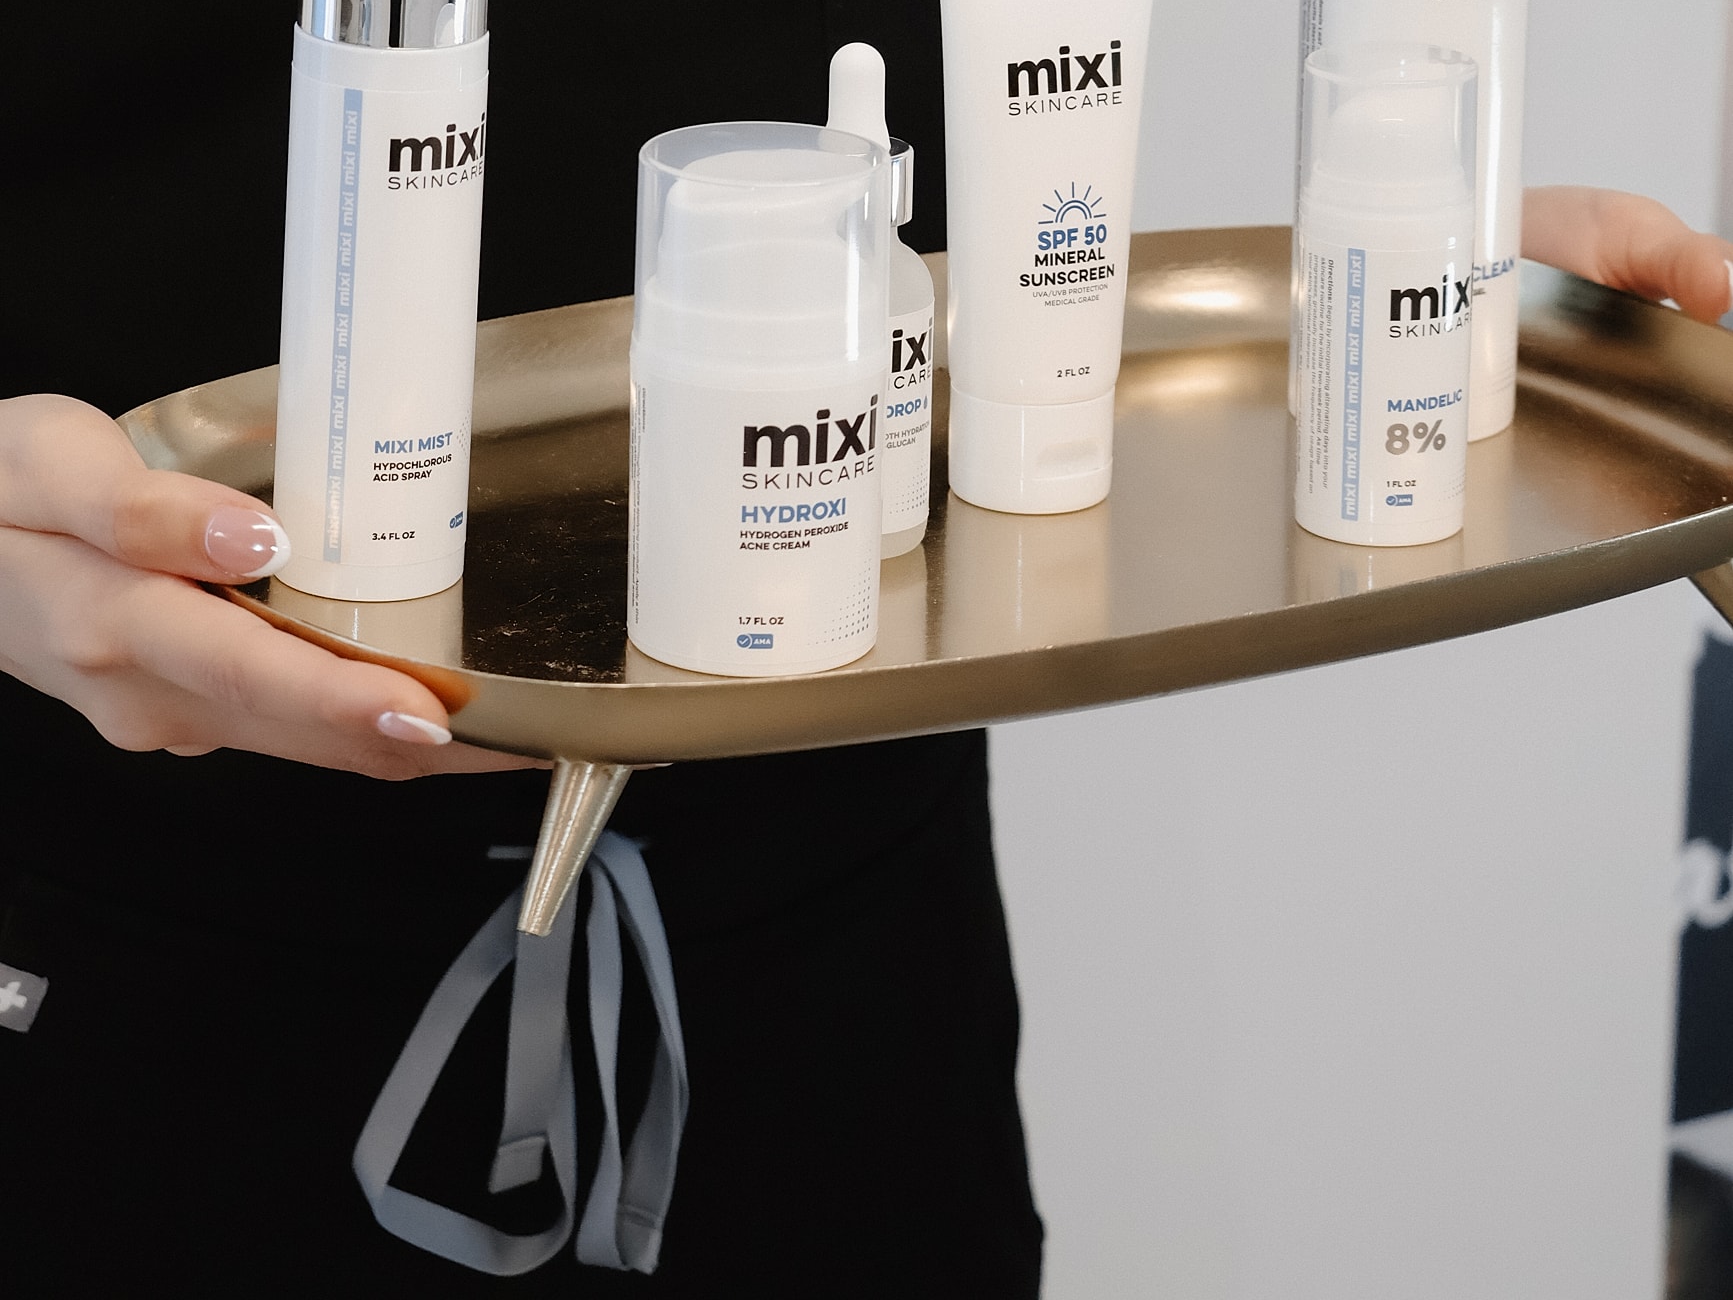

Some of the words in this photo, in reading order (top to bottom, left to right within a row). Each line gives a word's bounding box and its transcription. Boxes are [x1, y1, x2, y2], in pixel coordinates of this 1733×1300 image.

[1007, 40, 1121, 98] mixi
[1008, 91, 1122, 116] SKINCARE
[346, 110, 357, 145] mixi
[388, 111, 485, 172] mixi
[343, 151, 355, 186] mixi
[388, 160, 483, 190] SKINCARE
[342, 192, 354, 227] mixi
[340, 232, 352, 267] mixi
[1038, 228, 1078, 251] SPF
[1084, 224, 1107, 246] 50
[1034, 247, 1105, 267] MINERAL
[1350, 255, 1361, 288] mixi
[338, 272, 350, 307] mixi
[1019, 264, 1115, 288] SUNSCREEN
[1032, 289, 1067, 298] UVA/UVB
[1068, 283, 1108, 295] PROTECTION
[1044, 297, 1076, 307] MEDICAL
[1078, 294, 1099, 304] GRADE
[1349, 295, 1360, 328] mixi
[1390, 272, 1472, 321] mix
[336, 312, 349, 348] mixi
[1389, 312, 1471, 339] SKINCAR
[891, 317, 932, 373] ixi
[1348, 333, 1359, 365] mixi
[334, 354, 347, 390] mixi
[887, 364, 931, 391] CARE
[1057, 370, 1062, 378] 2
[1065, 368, 1076, 377] FL
[1078, 366, 1091, 376] OZ
[1347, 371, 1359, 404] mixi
[332, 395, 345, 429] mixi
[1387, 389, 1462, 412] MANDELIC
[743, 394, 878, 467] mixi
[1346, 409, 1357, 442] mixi
[1385, 419, 1446, 455] 8%
[331, 435, 344, 470] mixi
[374, 440, 413, 454] MIXI
[418, 432, 453, 452] MIST
[373, 454, 452, 470] HYPOCHLOROUS
[373, 473, 399, 482] ACID
[401, 469, 432, 481] SPRAY
[742, 454, 875, 490] SKINCARE
[1345, 446, 1357, 479] mixi
[741, 497, 847, 524] HYDROXI
[1344, 483, 1356, 516] mixi
[372, 533, 387, 541] 3.4
[388, 532, 400, 540] FL
[402, 531, 415, 539] OZ
[740, 528, 801, 539] HYDROGEN
[804, 521, 849, 537] PEROXIDE
[740, 542, 770, 550] ACNE
[772, 540, 811, 550] CREAM
[738, 616, 752, 625] 1.7
[753, 616, 767, 626] FL
[768, 616, 785, 625] OZ
